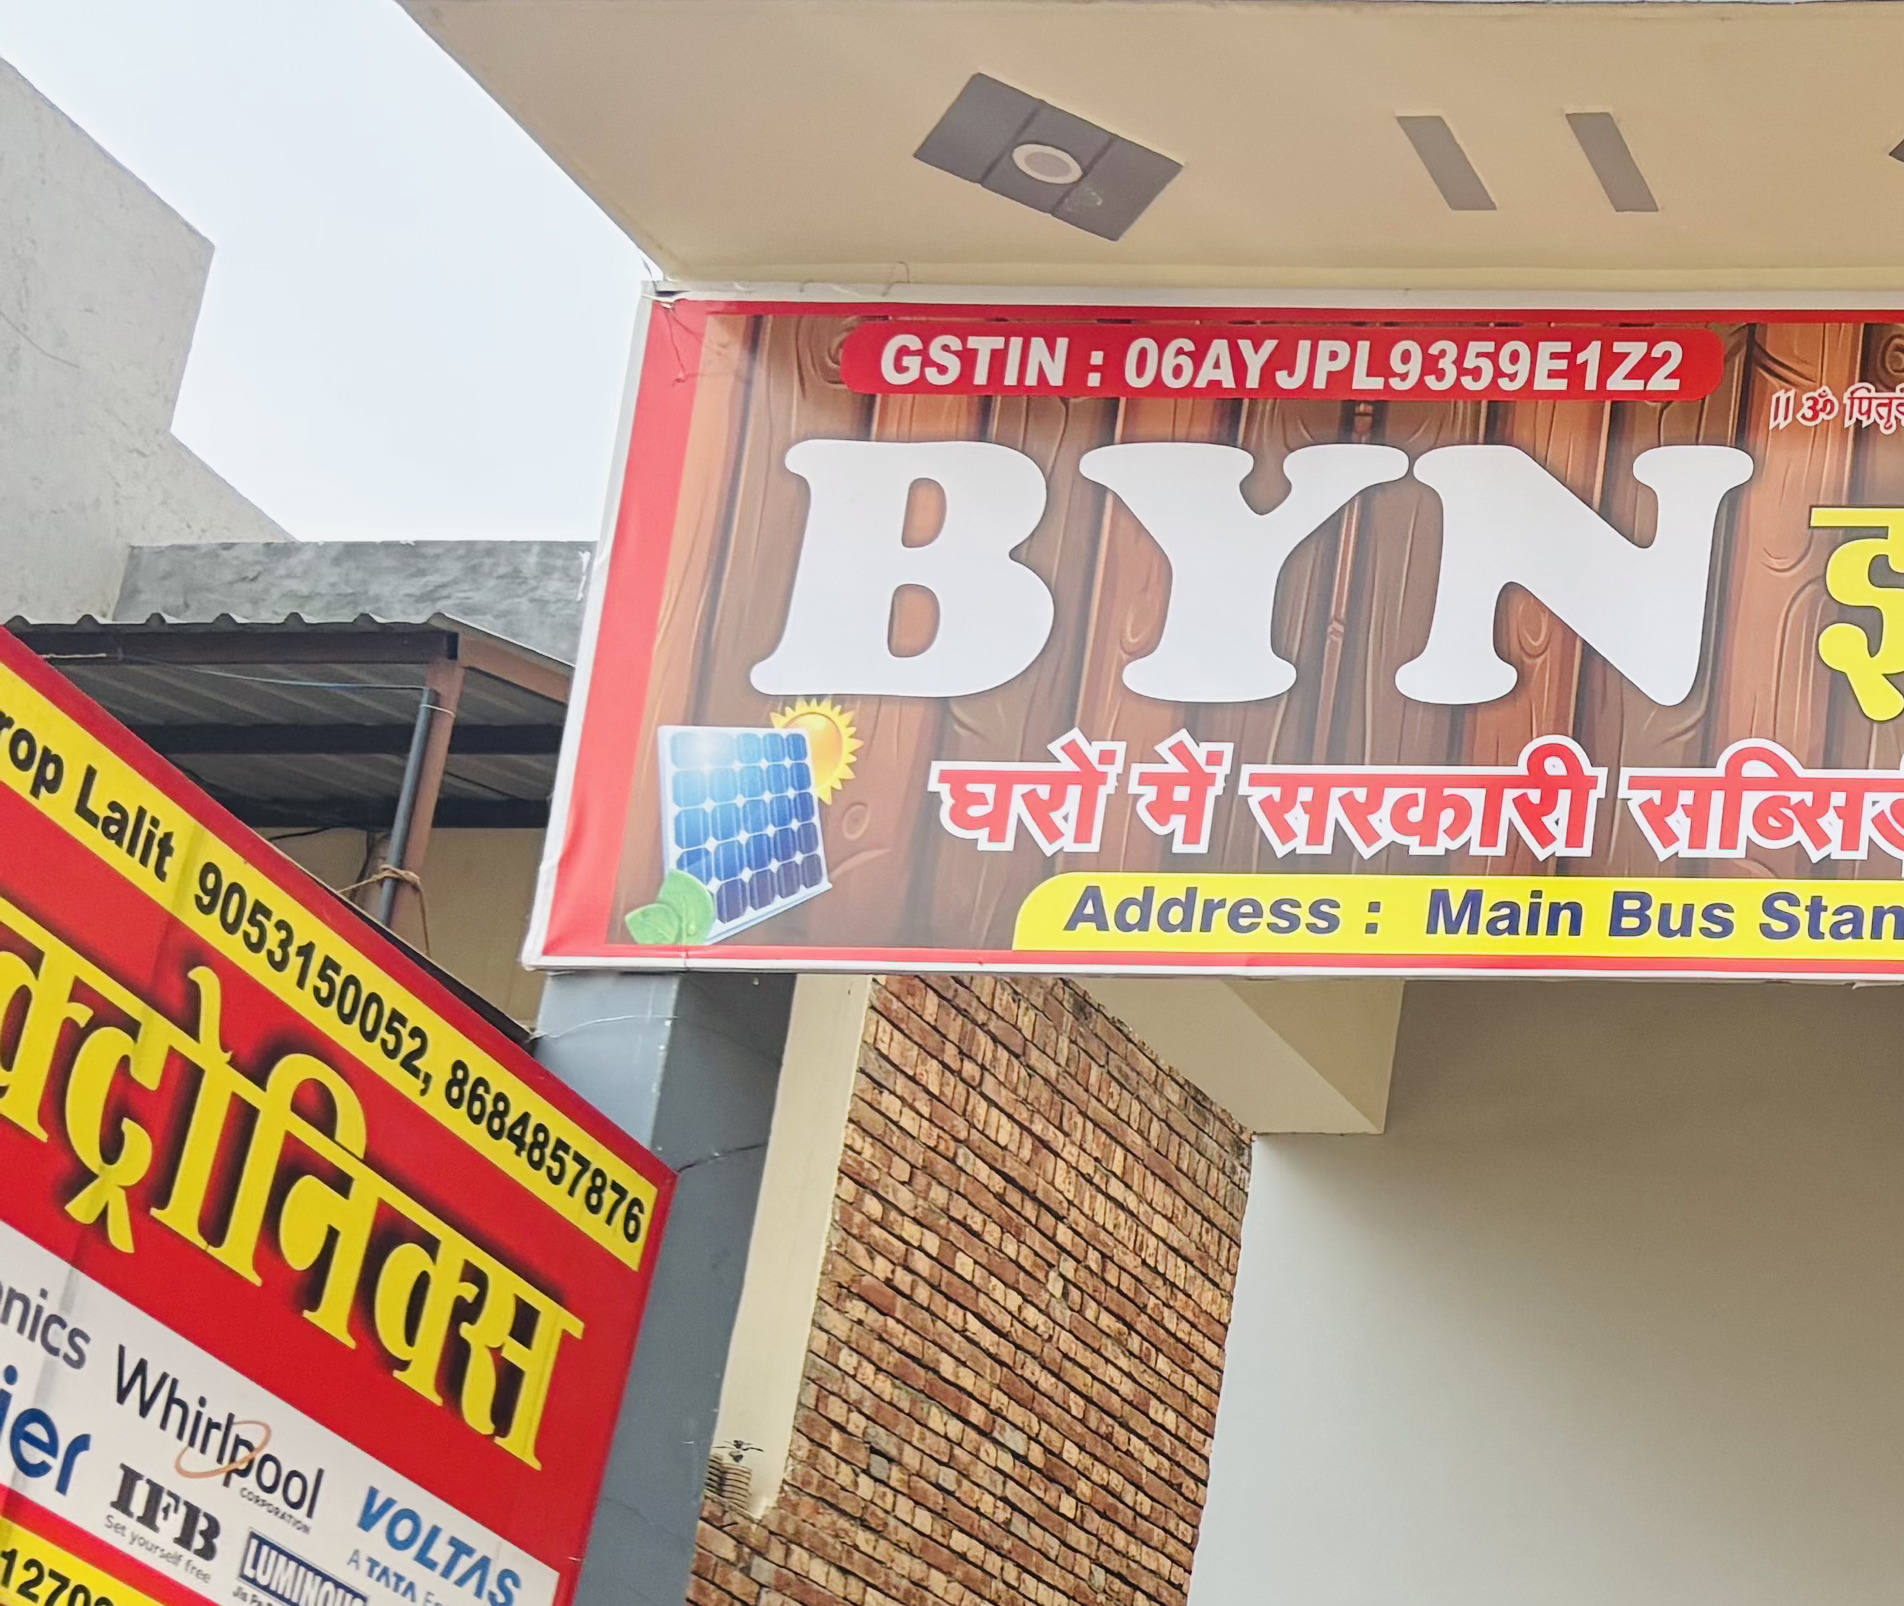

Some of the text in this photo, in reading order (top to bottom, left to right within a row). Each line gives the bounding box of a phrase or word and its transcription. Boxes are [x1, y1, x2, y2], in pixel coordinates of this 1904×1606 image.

[881, 332, 1067, 386] GSTIN
[1124, 337, 1683, 391] 06AYJPL9359E1Z2
[1798, 385, 1839, 427] ॐ
[749, 437, 1754, 709] BYN
[930, 727, 1122, 858] घरों
[1129, 728, 1234, 856] में
[1239, 733, 1605, 859] सरकारी
[1064, 885, 1342, 937] Address
[1426, 888, 1583, 938] Main
[1608, 890, 1734, 941] Bus
[74, 763, 175, 883] Lalit
[194, 861, 433, 1097] 9053150052,
[445, 1060, 646, 1245] 8684857876
[0, 1285, 92, 1370] nics
[116, 1343, 325, 1519] Whirlpool
[104, 1514, 211, 1584] Set yourself free
[110, 1462, 221, 1562] IFB
[239, 1486, 312, 1535] CORPORATION
[347, 1548, 361, 1571] A
[365, 1555, 417, 1603] TATA
